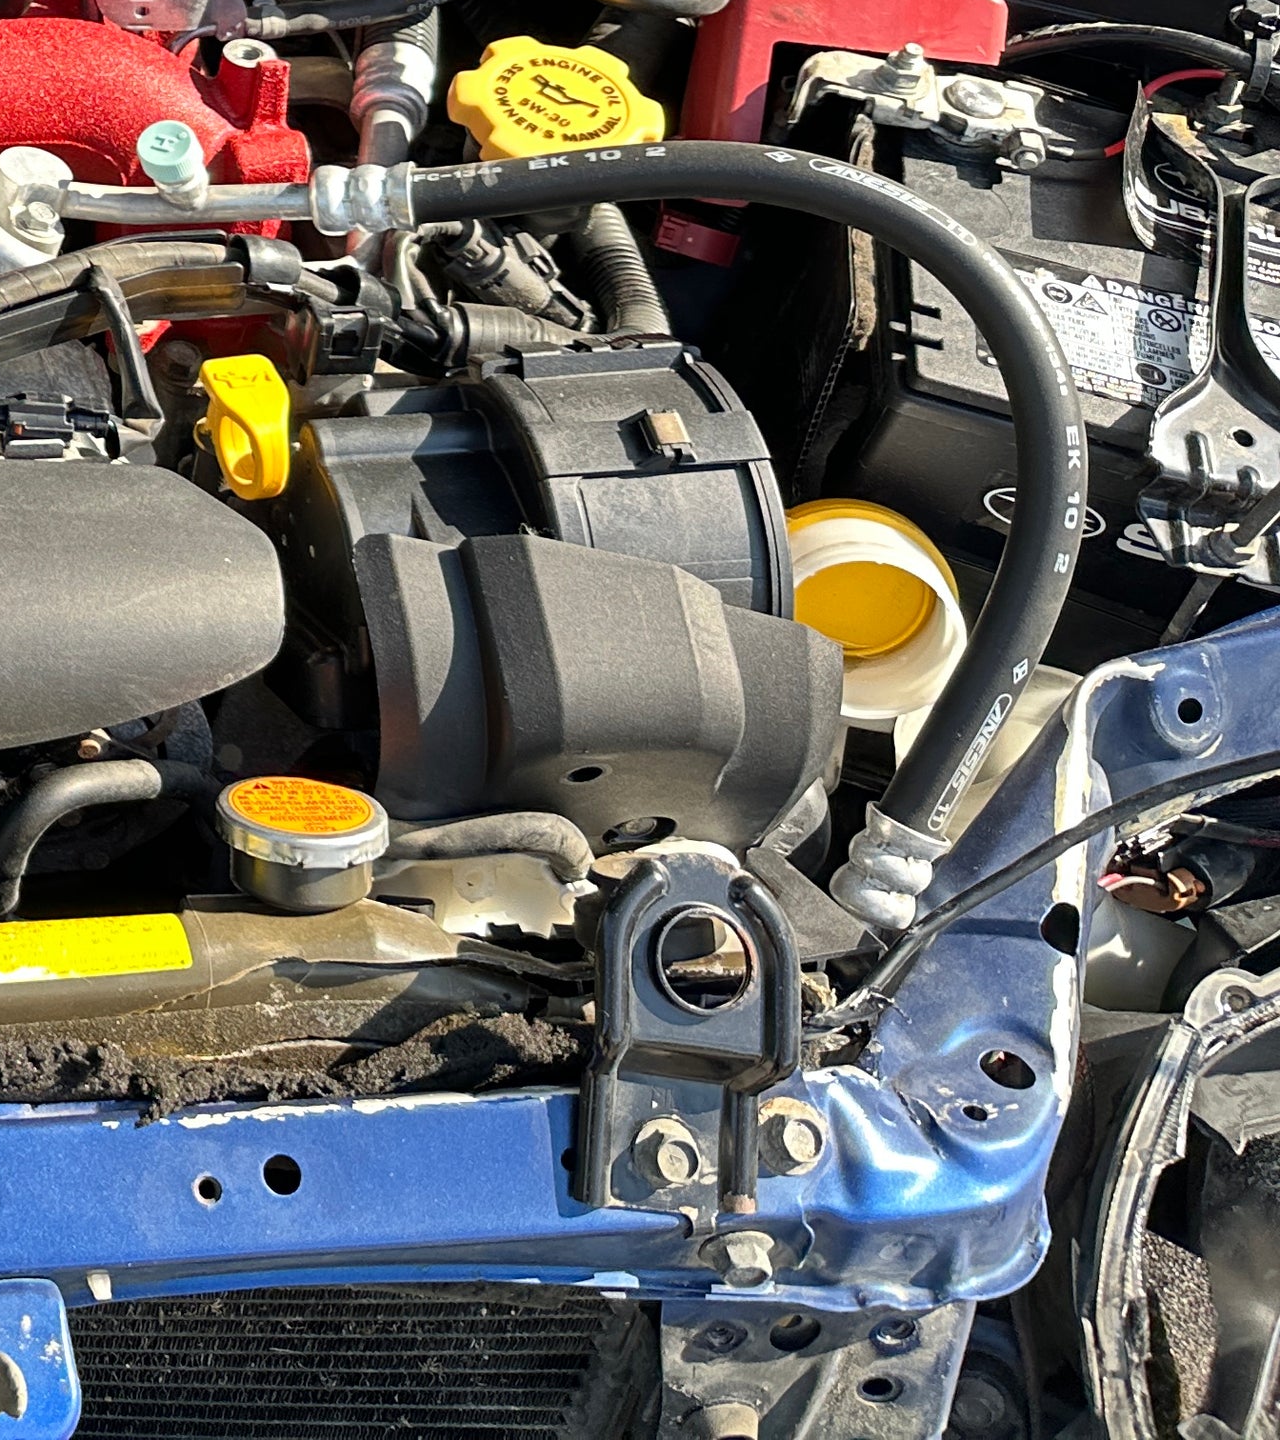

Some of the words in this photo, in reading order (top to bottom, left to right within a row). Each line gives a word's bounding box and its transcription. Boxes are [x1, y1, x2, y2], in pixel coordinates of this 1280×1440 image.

[496, 63, 524, 84] SEE
[529, 57, 604, 83] ENGINE
[600, 85, 622, 107] OIL
[494, 86, 555, 140] OWNER'S
[518, 97, 572, 128] 5W-30
[561, 115, 622, 143] MANUAL
[528, 153, 569, 171] EK
[584, 149, 622, 162] 10
[645, 146, 666, 158] 2
[1065, 425, 1081, 470] EK
[1063, 491, 1080, 530] 10
[1053, 552, 1070, 574] 2
